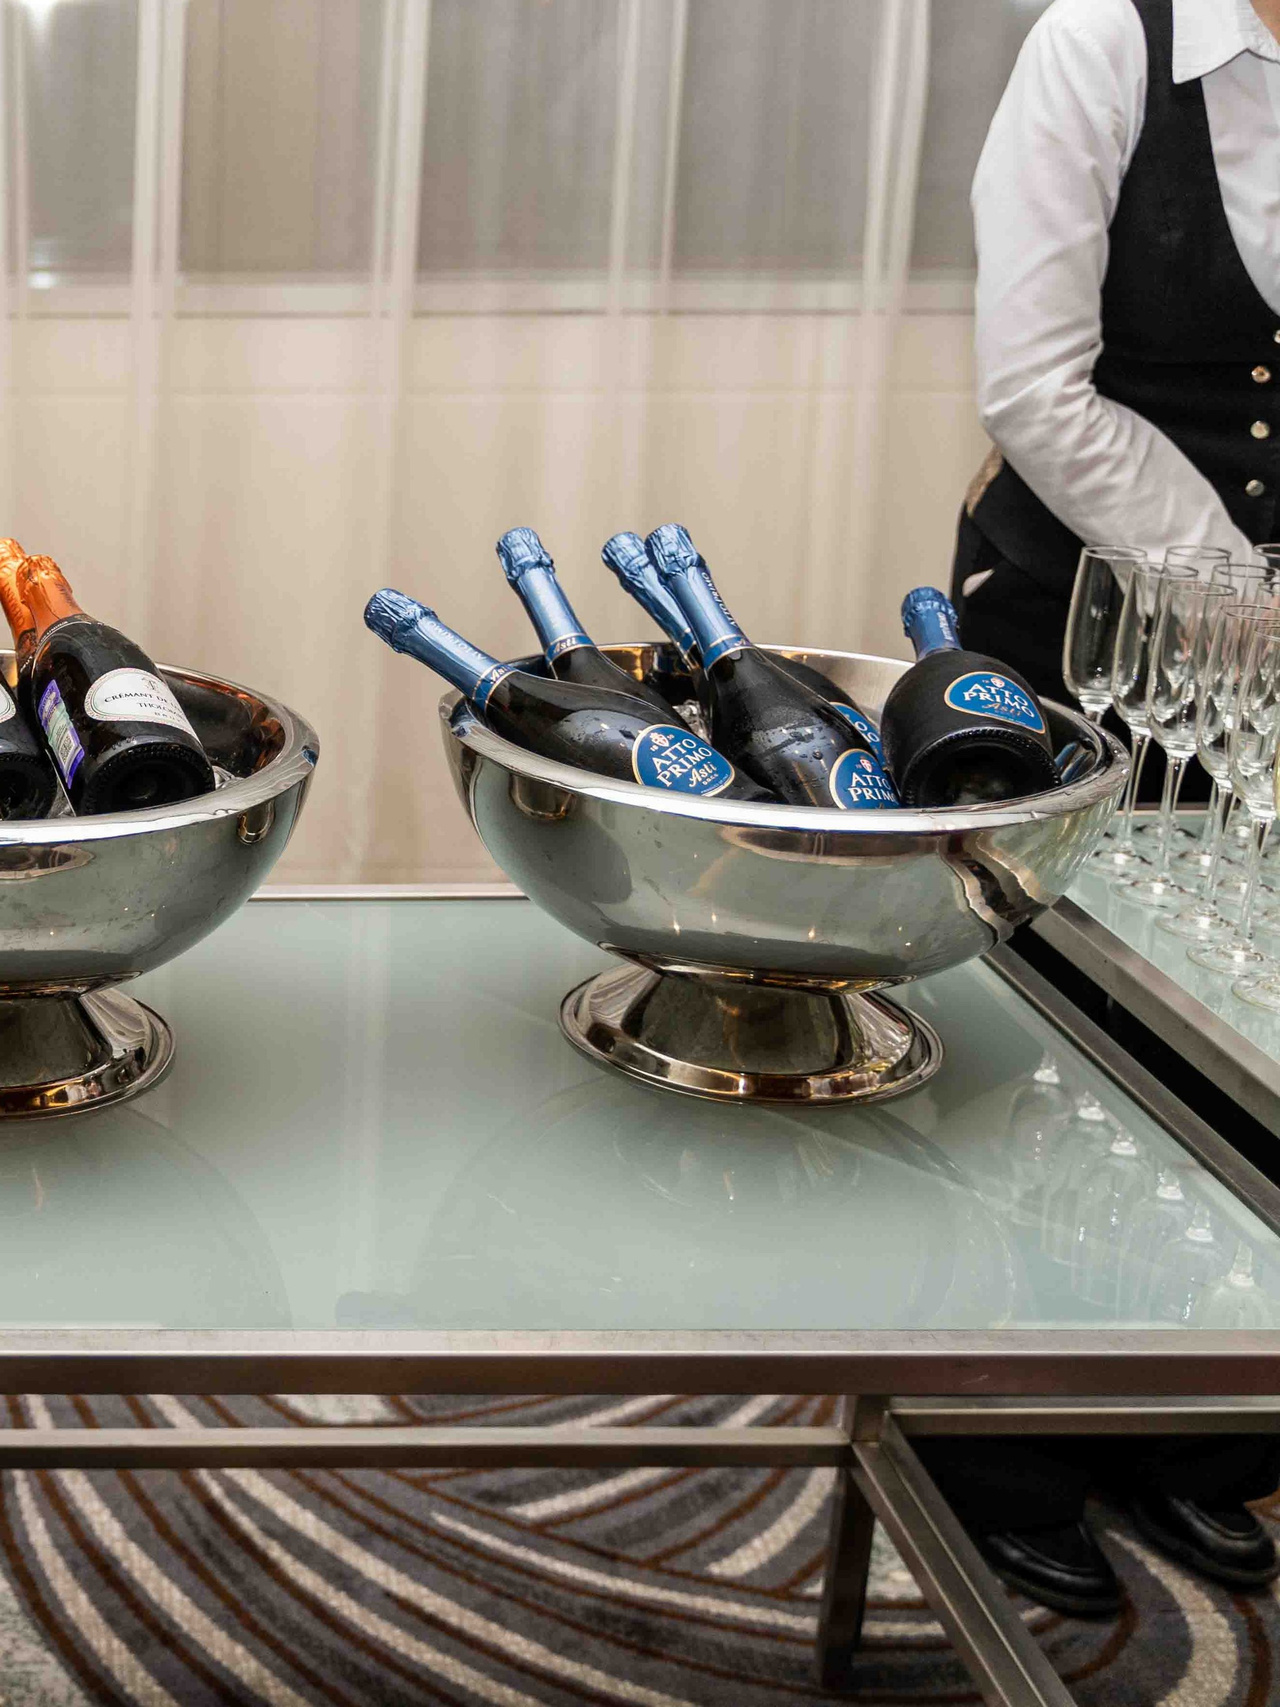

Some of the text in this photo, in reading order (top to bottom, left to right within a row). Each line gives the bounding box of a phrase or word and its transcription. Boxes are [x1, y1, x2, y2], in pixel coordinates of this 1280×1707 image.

[104, 692, 153, 703] CRÉMANT
[963, 691, 1035, 718] PRIMO
[967, 683, 1028, 707] ATTO
[982, 702, 1021, 717] Asti
[652, 738, 697, 773] ATTO
[656, 746, 713, 787] PRIMO
[689, 761, 717, 788] Asti
[851, 772, 892, 790] ATTO
